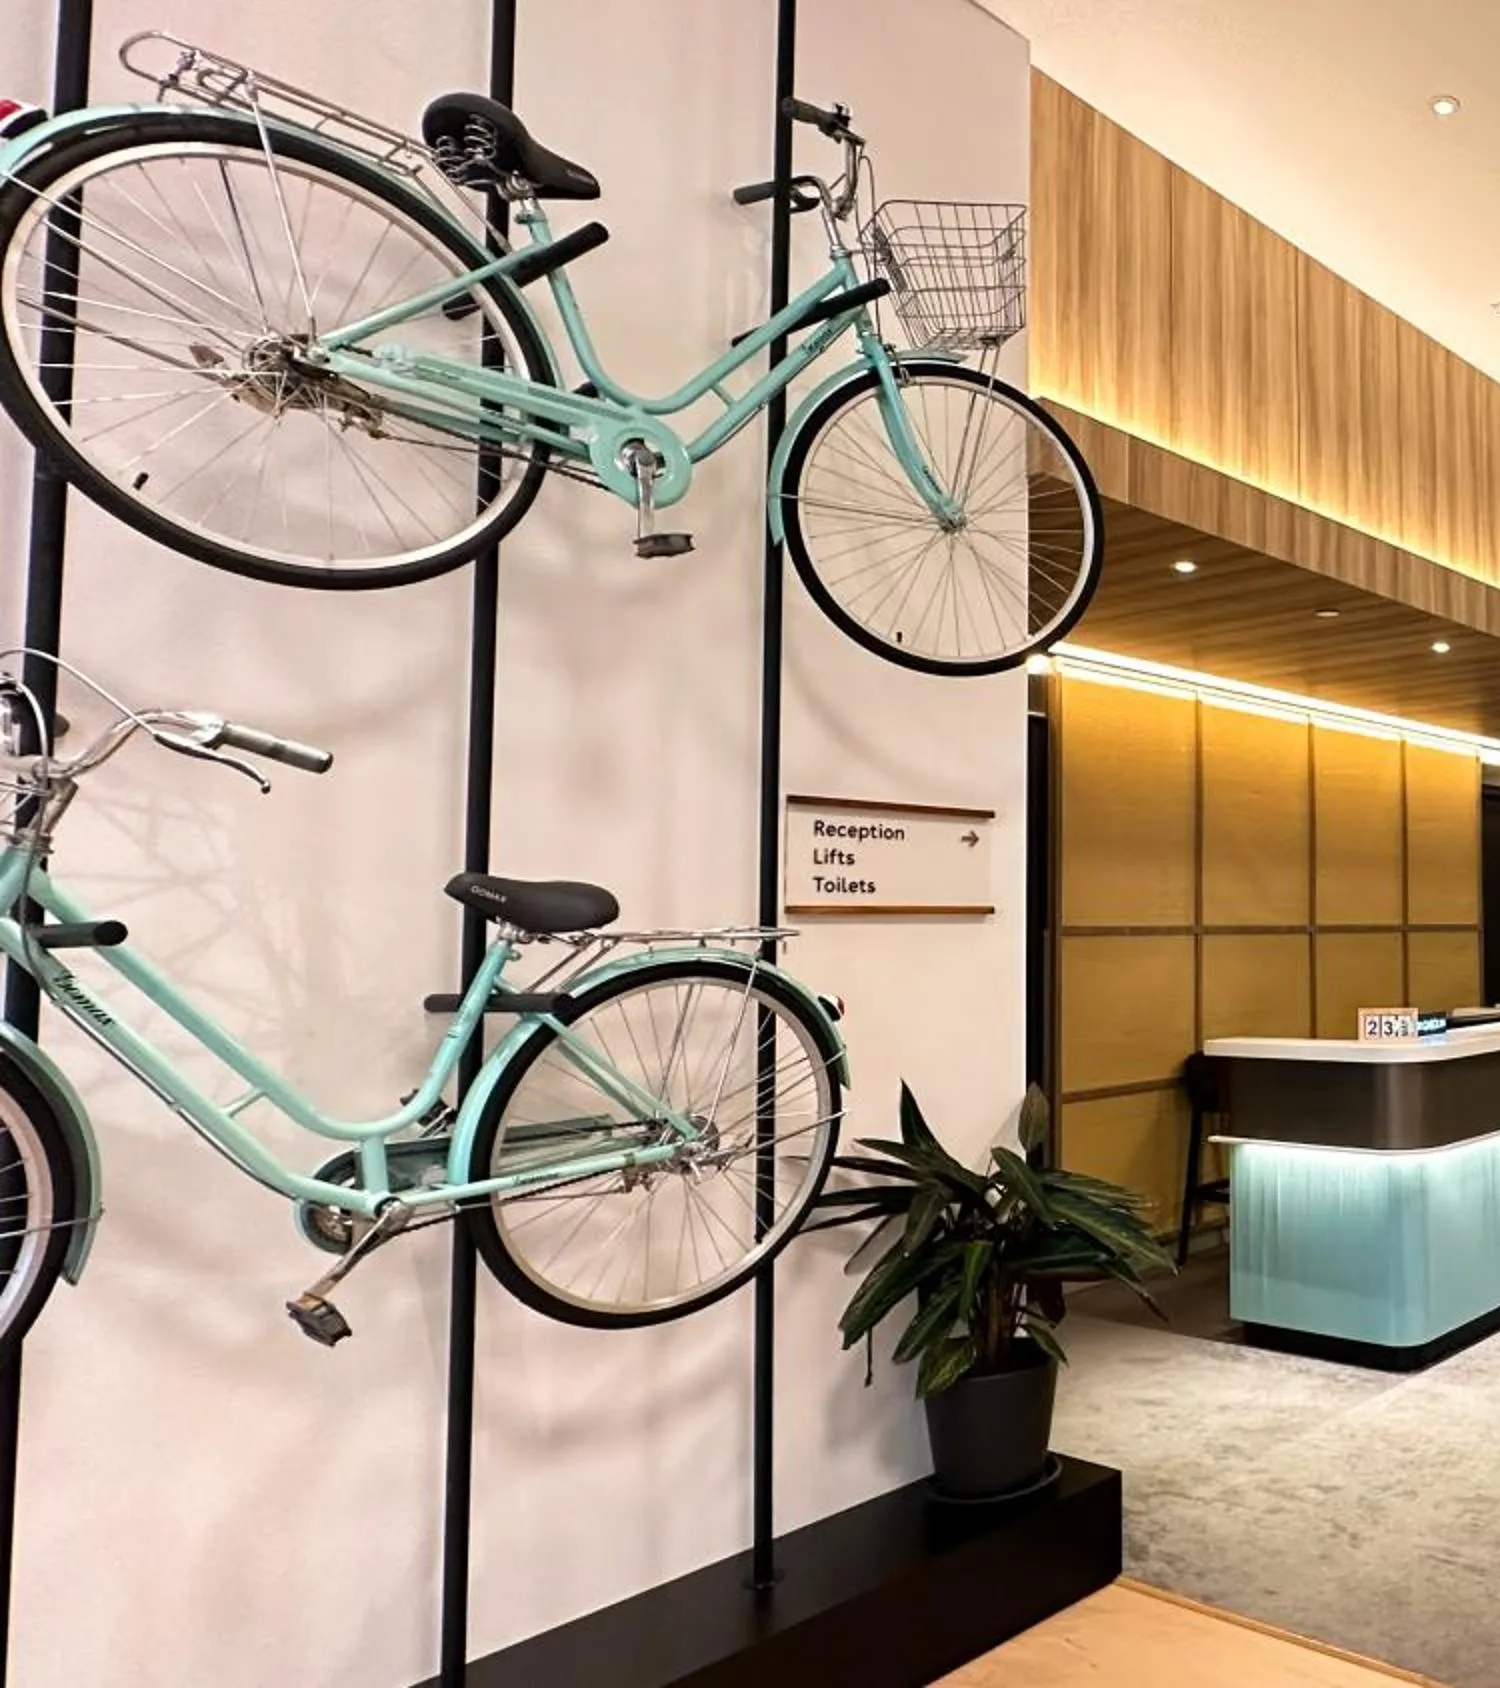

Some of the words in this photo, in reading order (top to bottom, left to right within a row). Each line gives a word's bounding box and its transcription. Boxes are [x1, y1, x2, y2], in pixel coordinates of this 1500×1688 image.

[813, 820, 905, 842] Reception
[813, 848, 856, 866] Lifts
[813, 876, 876, 893] Toilets
